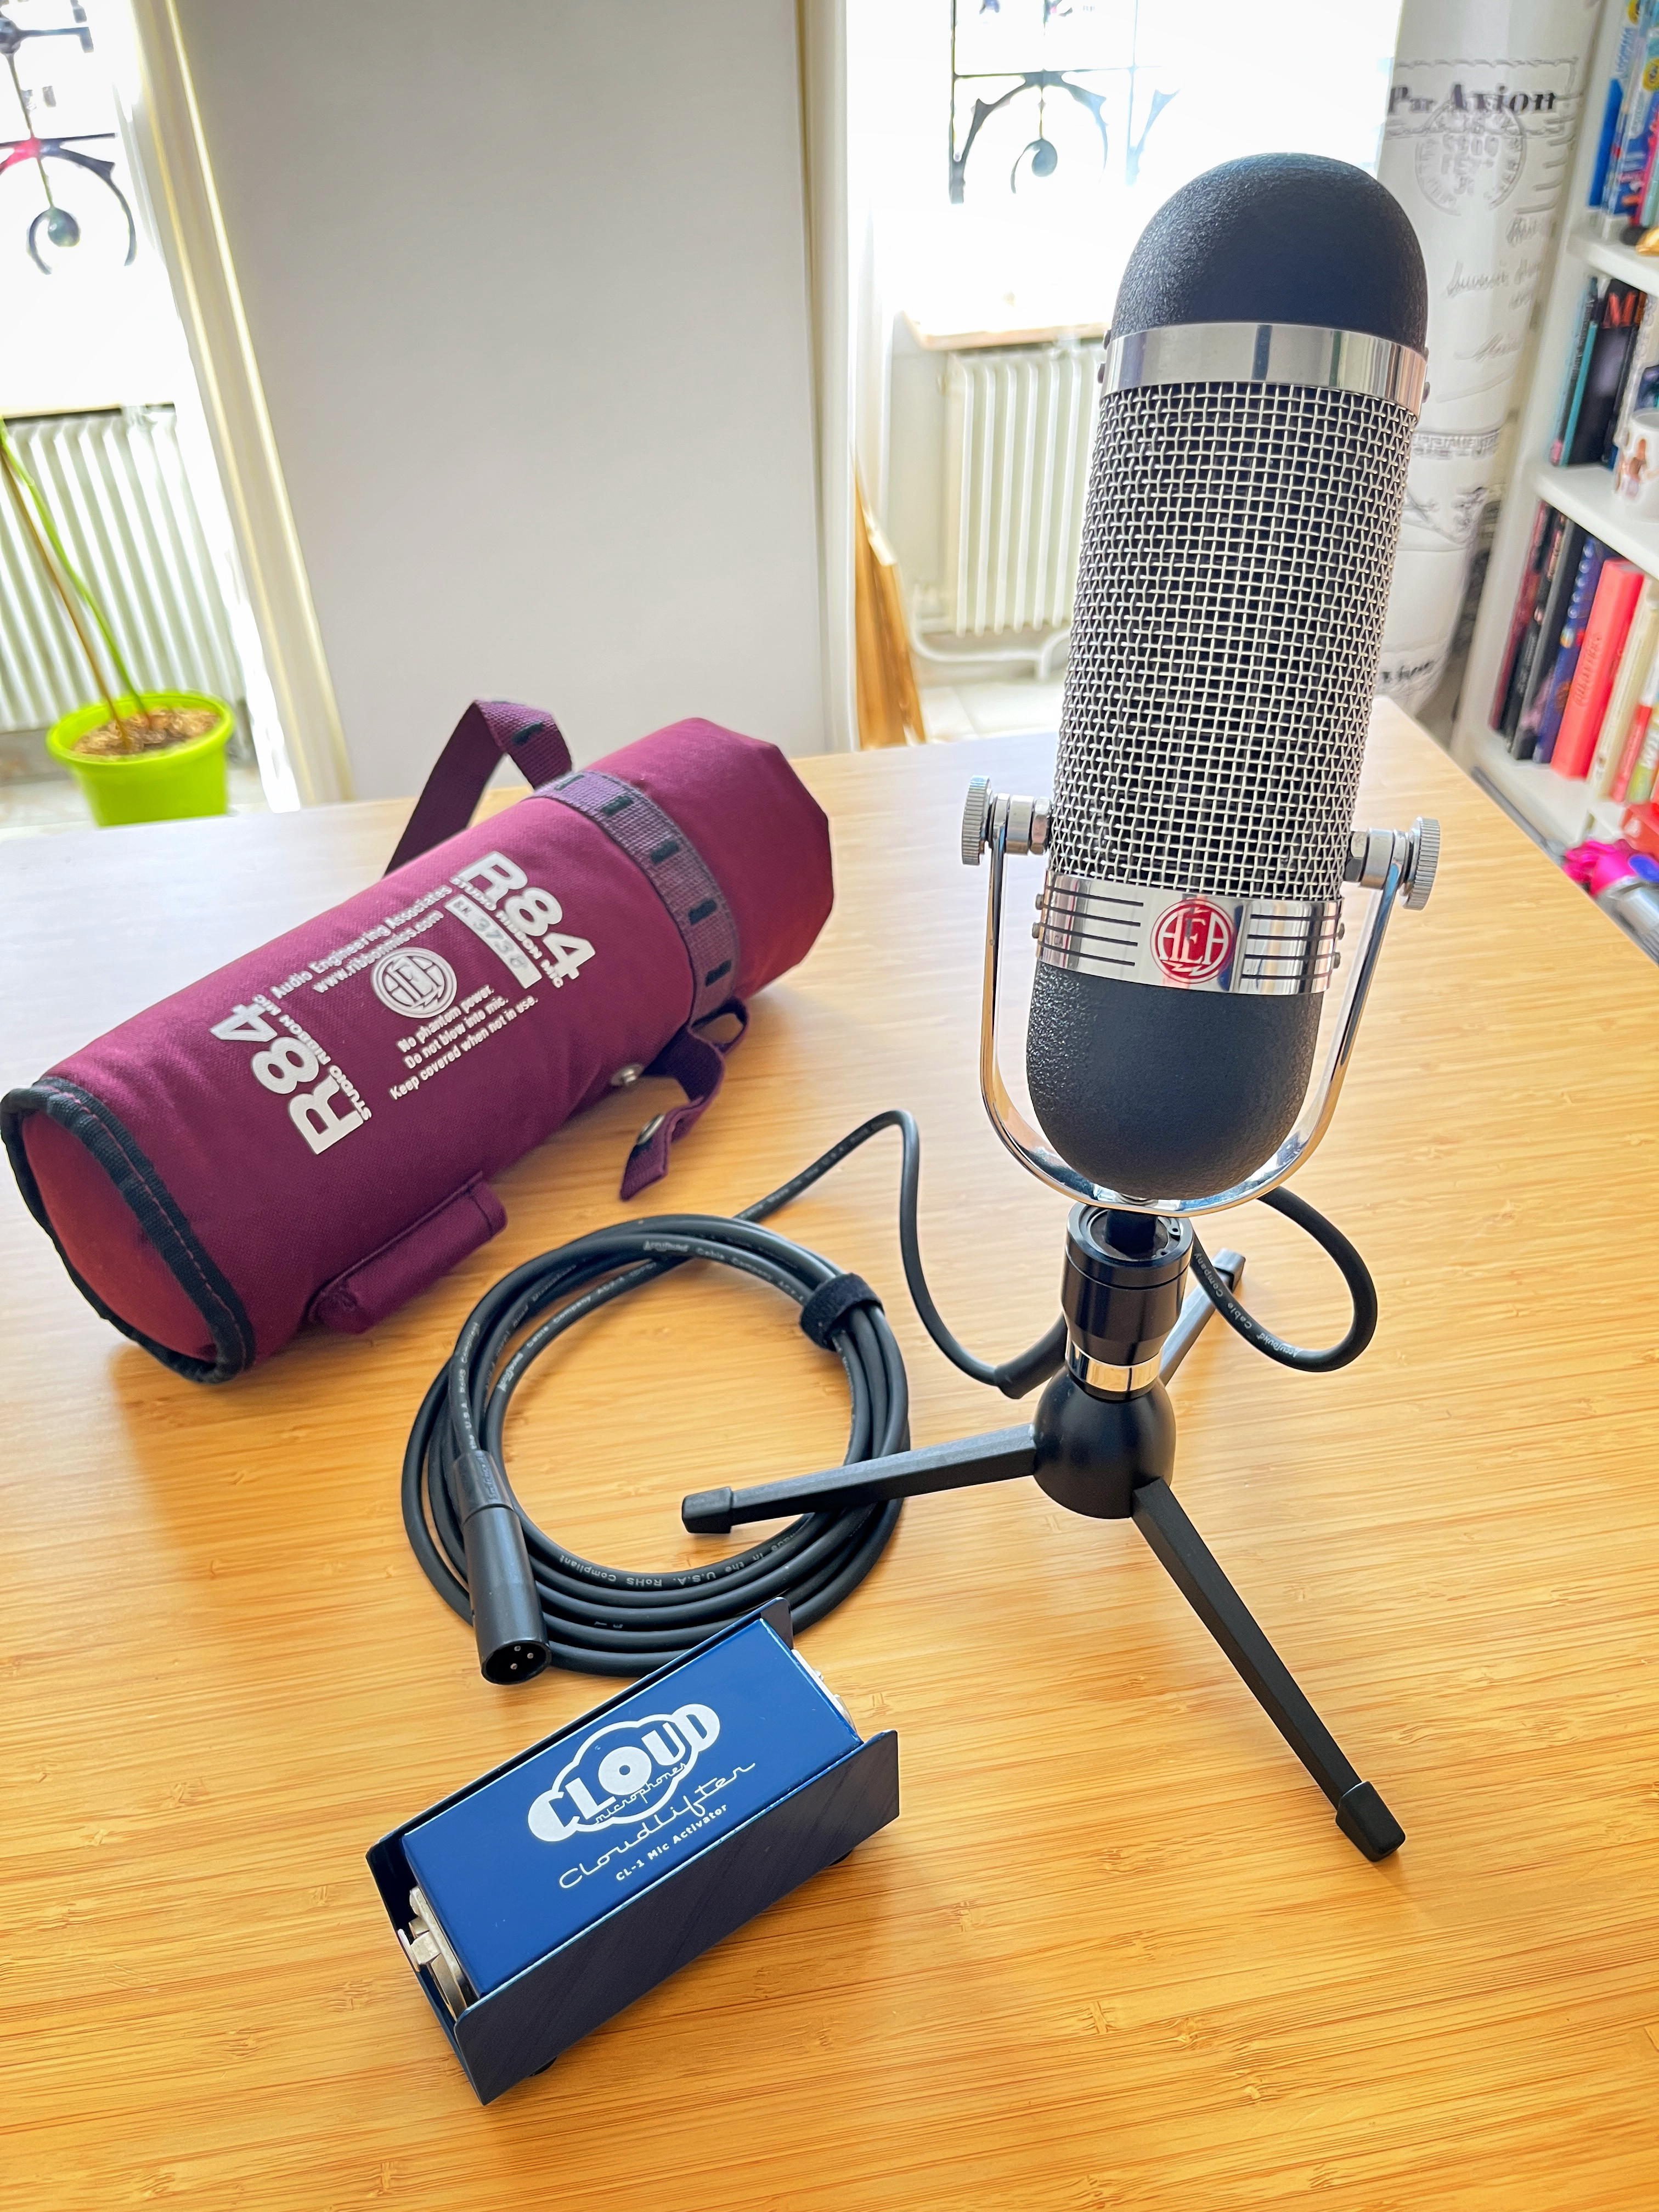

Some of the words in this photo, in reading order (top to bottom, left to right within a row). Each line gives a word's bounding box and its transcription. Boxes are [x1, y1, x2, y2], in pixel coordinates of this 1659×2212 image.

[270, 970, 313, 999] Audio
[307, 924, 392, 974] Engineering
[384, 885, 453, 929] Associates
[449, 877, 496, 911] STUDIO
[496, 910, 542, 959] RIBBON
[541, 960, 563, 988] MIC
[457, 851, 595, 979] R84
[1156, 906, 1230, 977] AEA
[312, 910, 444, 993] www.ribbonmics.com
[252, 994, 281, 1015] MIC
[396, 1035, 417, 1053] No
[415, 1006, 462, 1044] phantom
[459, 984, 495, 1014] power.
[403, 1052, 423, 1069] Do
[421, 1039, 442, 1058] not
[438, 1022, 466, 1046] blow
[463, 1009, 487, 1029] into
[484, 995, 509, 1015] mic.
[279, 1014, 331, 1065] RIBBON
[389, 1075, 420, 1101] Keep
[418, 1055, 462, 1081] covered
[460, 1026, 489, 1052] when
[487, 1014, 507, 1034] not
[502, 1007, 517, 1022] in
[515, 995, 539, 1014] use.
[210, 1003, 364, 1154] R84
[329, 1064, 372, 1121] STUDIO
[1194, 1253, 1223, 1297] Company
[1227, 1302, 1252, 1329] Cable
[558, 1554, 617, 1583] Compliant
[627, 1577, 663, 1587] RoHS
[673, 1571, 716, 1586] U.S.A.
[725, 1561, 744, 1572] the
[751, 1551, 765, 1563] in
[528, 1703, 720, 1842] CLOUD
[594, 1761, 686, 1825] microphones
[558, 1762, 756, 1889] Cloudlifter
[616, 1859, 645, 1882] CL-1
[647, 1842, 670, 1860] Mic
[673, 1803, 727, 1844] Activator
